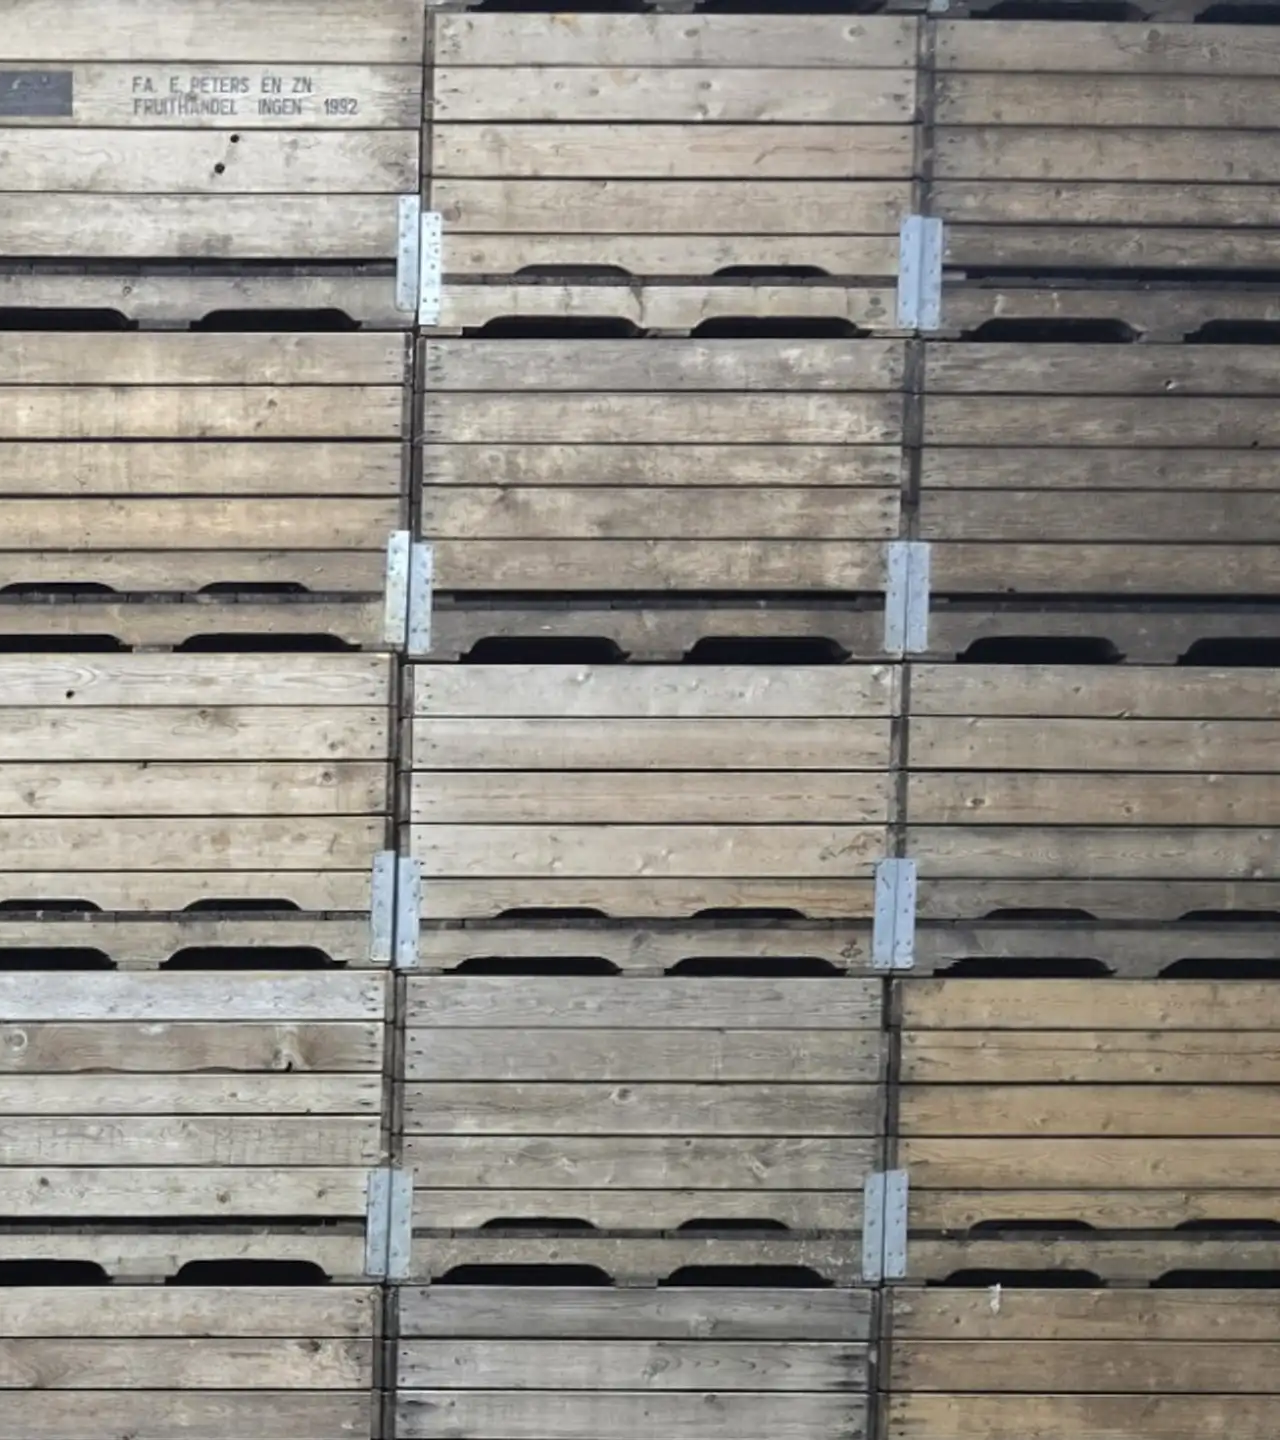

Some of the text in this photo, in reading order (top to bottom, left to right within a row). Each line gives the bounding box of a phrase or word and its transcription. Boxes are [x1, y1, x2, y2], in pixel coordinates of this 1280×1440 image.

[132, 76, 158, 93] FA.
[190, 76, 250, 93] PETERS
[261, 76, 282, 93] EN
[292, 76, 312, 93] ZN
[133, 98, 360, 115] FRUITHANDEL INGEN 1992
